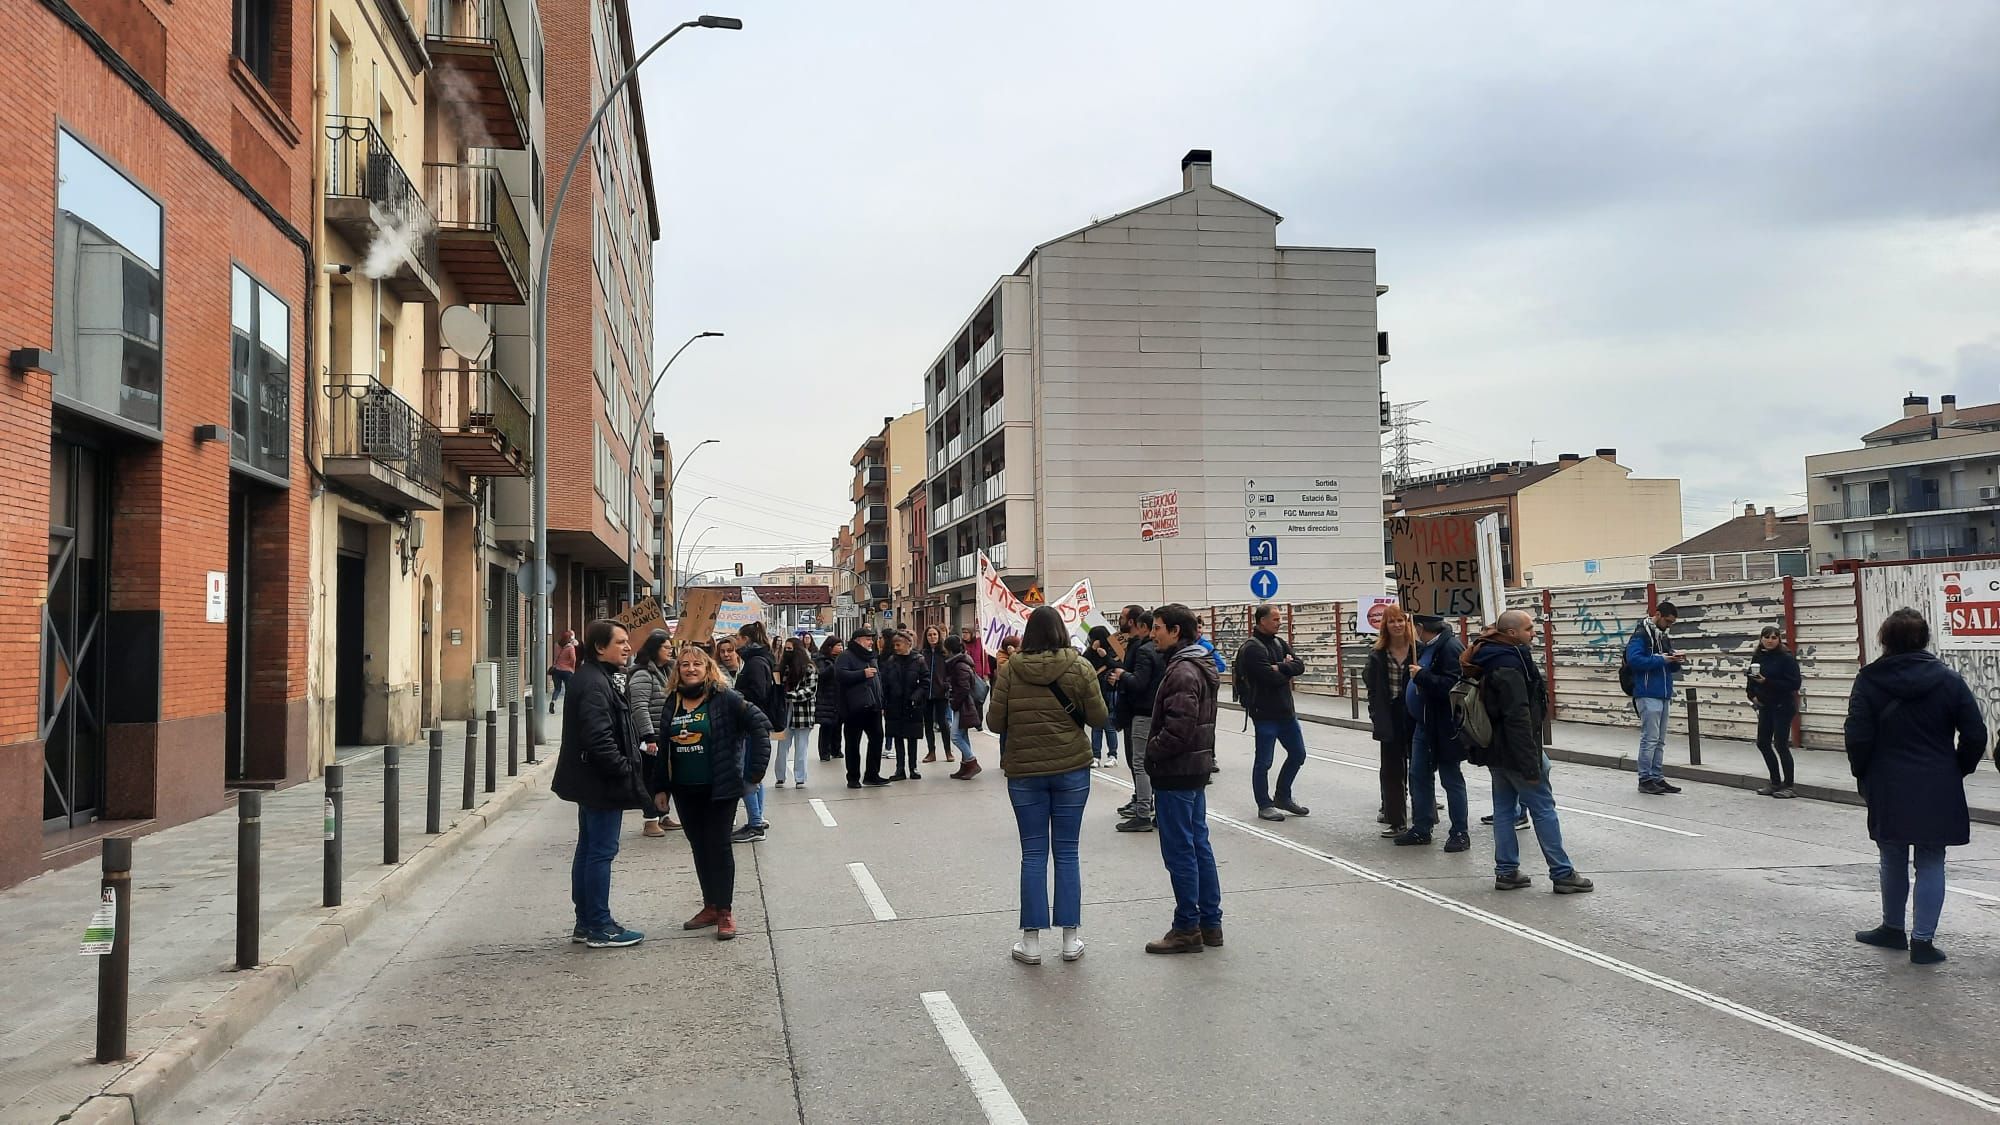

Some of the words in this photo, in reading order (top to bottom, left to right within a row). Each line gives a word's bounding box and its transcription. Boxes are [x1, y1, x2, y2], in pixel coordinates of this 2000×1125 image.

[1315, 479, 1338, 487] Sortida
[1302, 494, 1325, 502] Estació
[1283, 509, 1297, 517] FGC
[1298, 509, 1325, 517] Manresa
[1326, 509, 1338, 517] Alta
[1287, 524, 1306, 532] Altres
[1307, 524, 1339, 532] direccions
[1953, 608, 2000, 630] SAL
